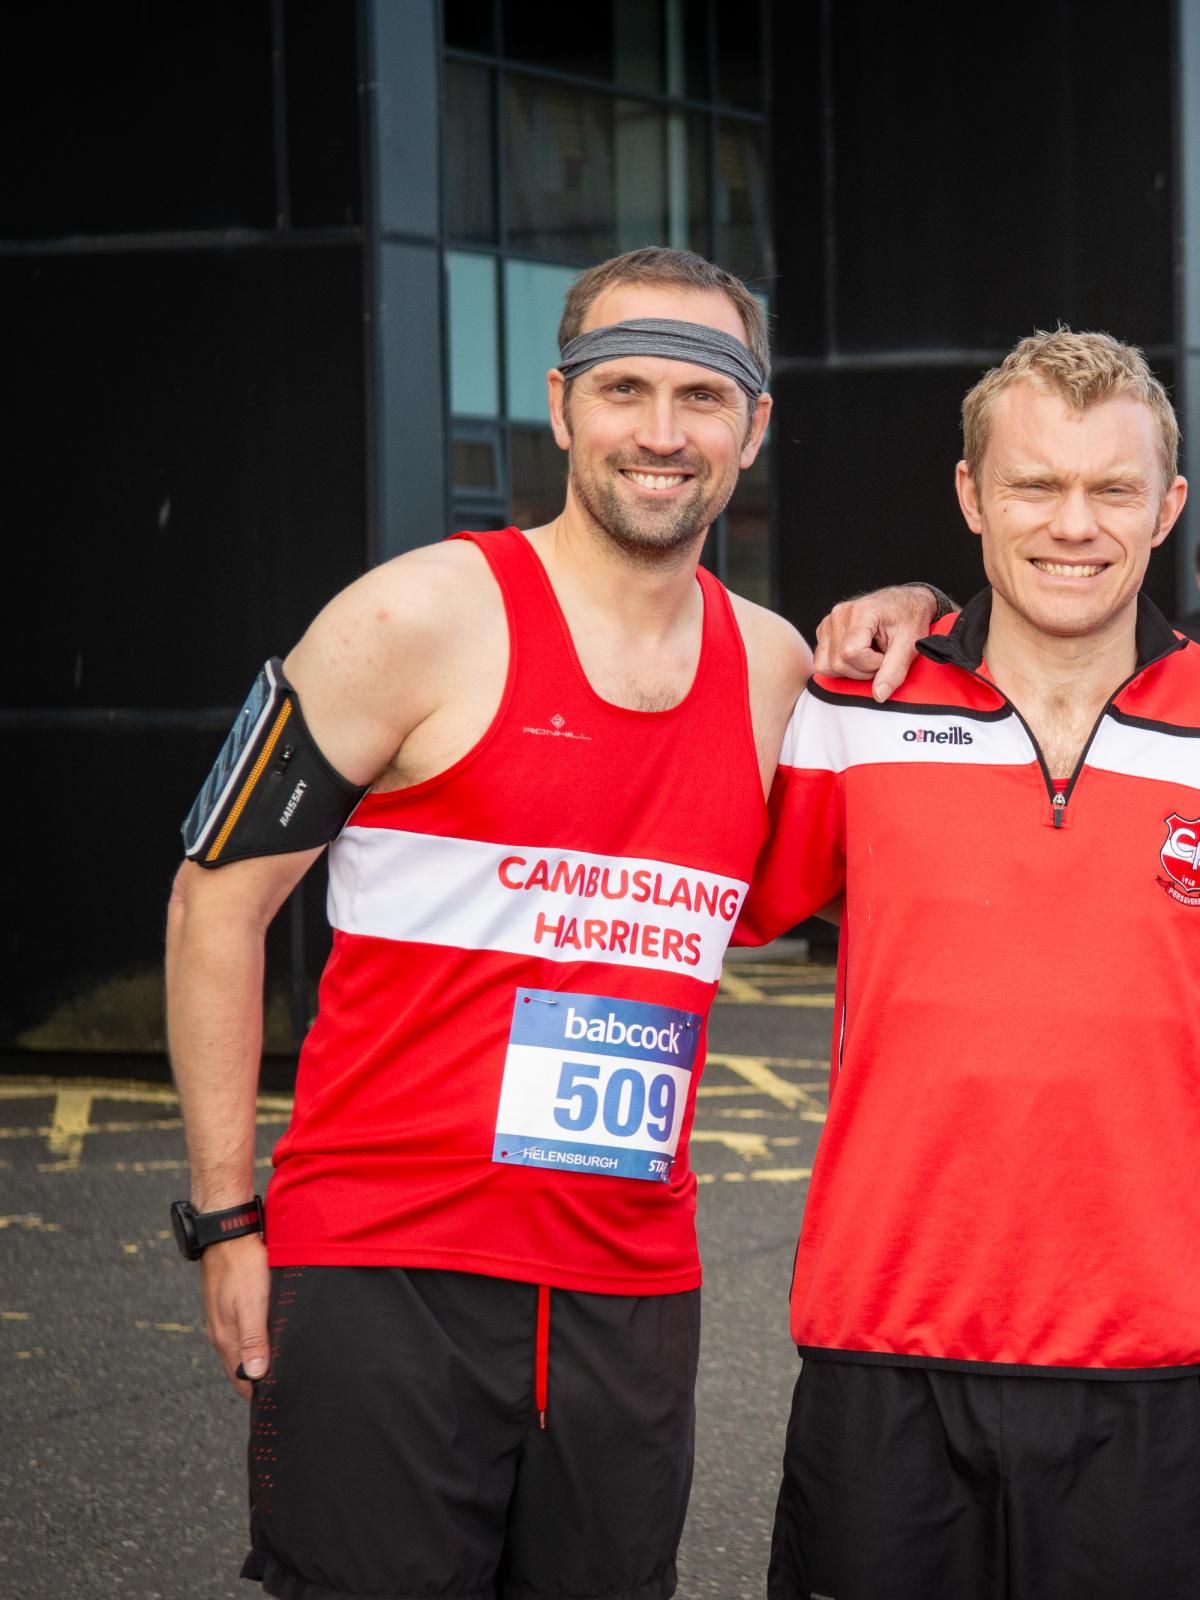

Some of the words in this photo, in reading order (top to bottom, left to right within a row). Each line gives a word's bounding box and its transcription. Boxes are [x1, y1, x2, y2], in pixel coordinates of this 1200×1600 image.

[523, 727, 592, 741] RONHILL
[498, 856, 739, 922] CAMBUSLANG
[534, 911, 702, 966] HARRIERS
[564, 1007, 681, 1055] babcock
[553, 1061, 677, 1143] 509
[522, 1147, 618, 1169] HELENSBURGH
